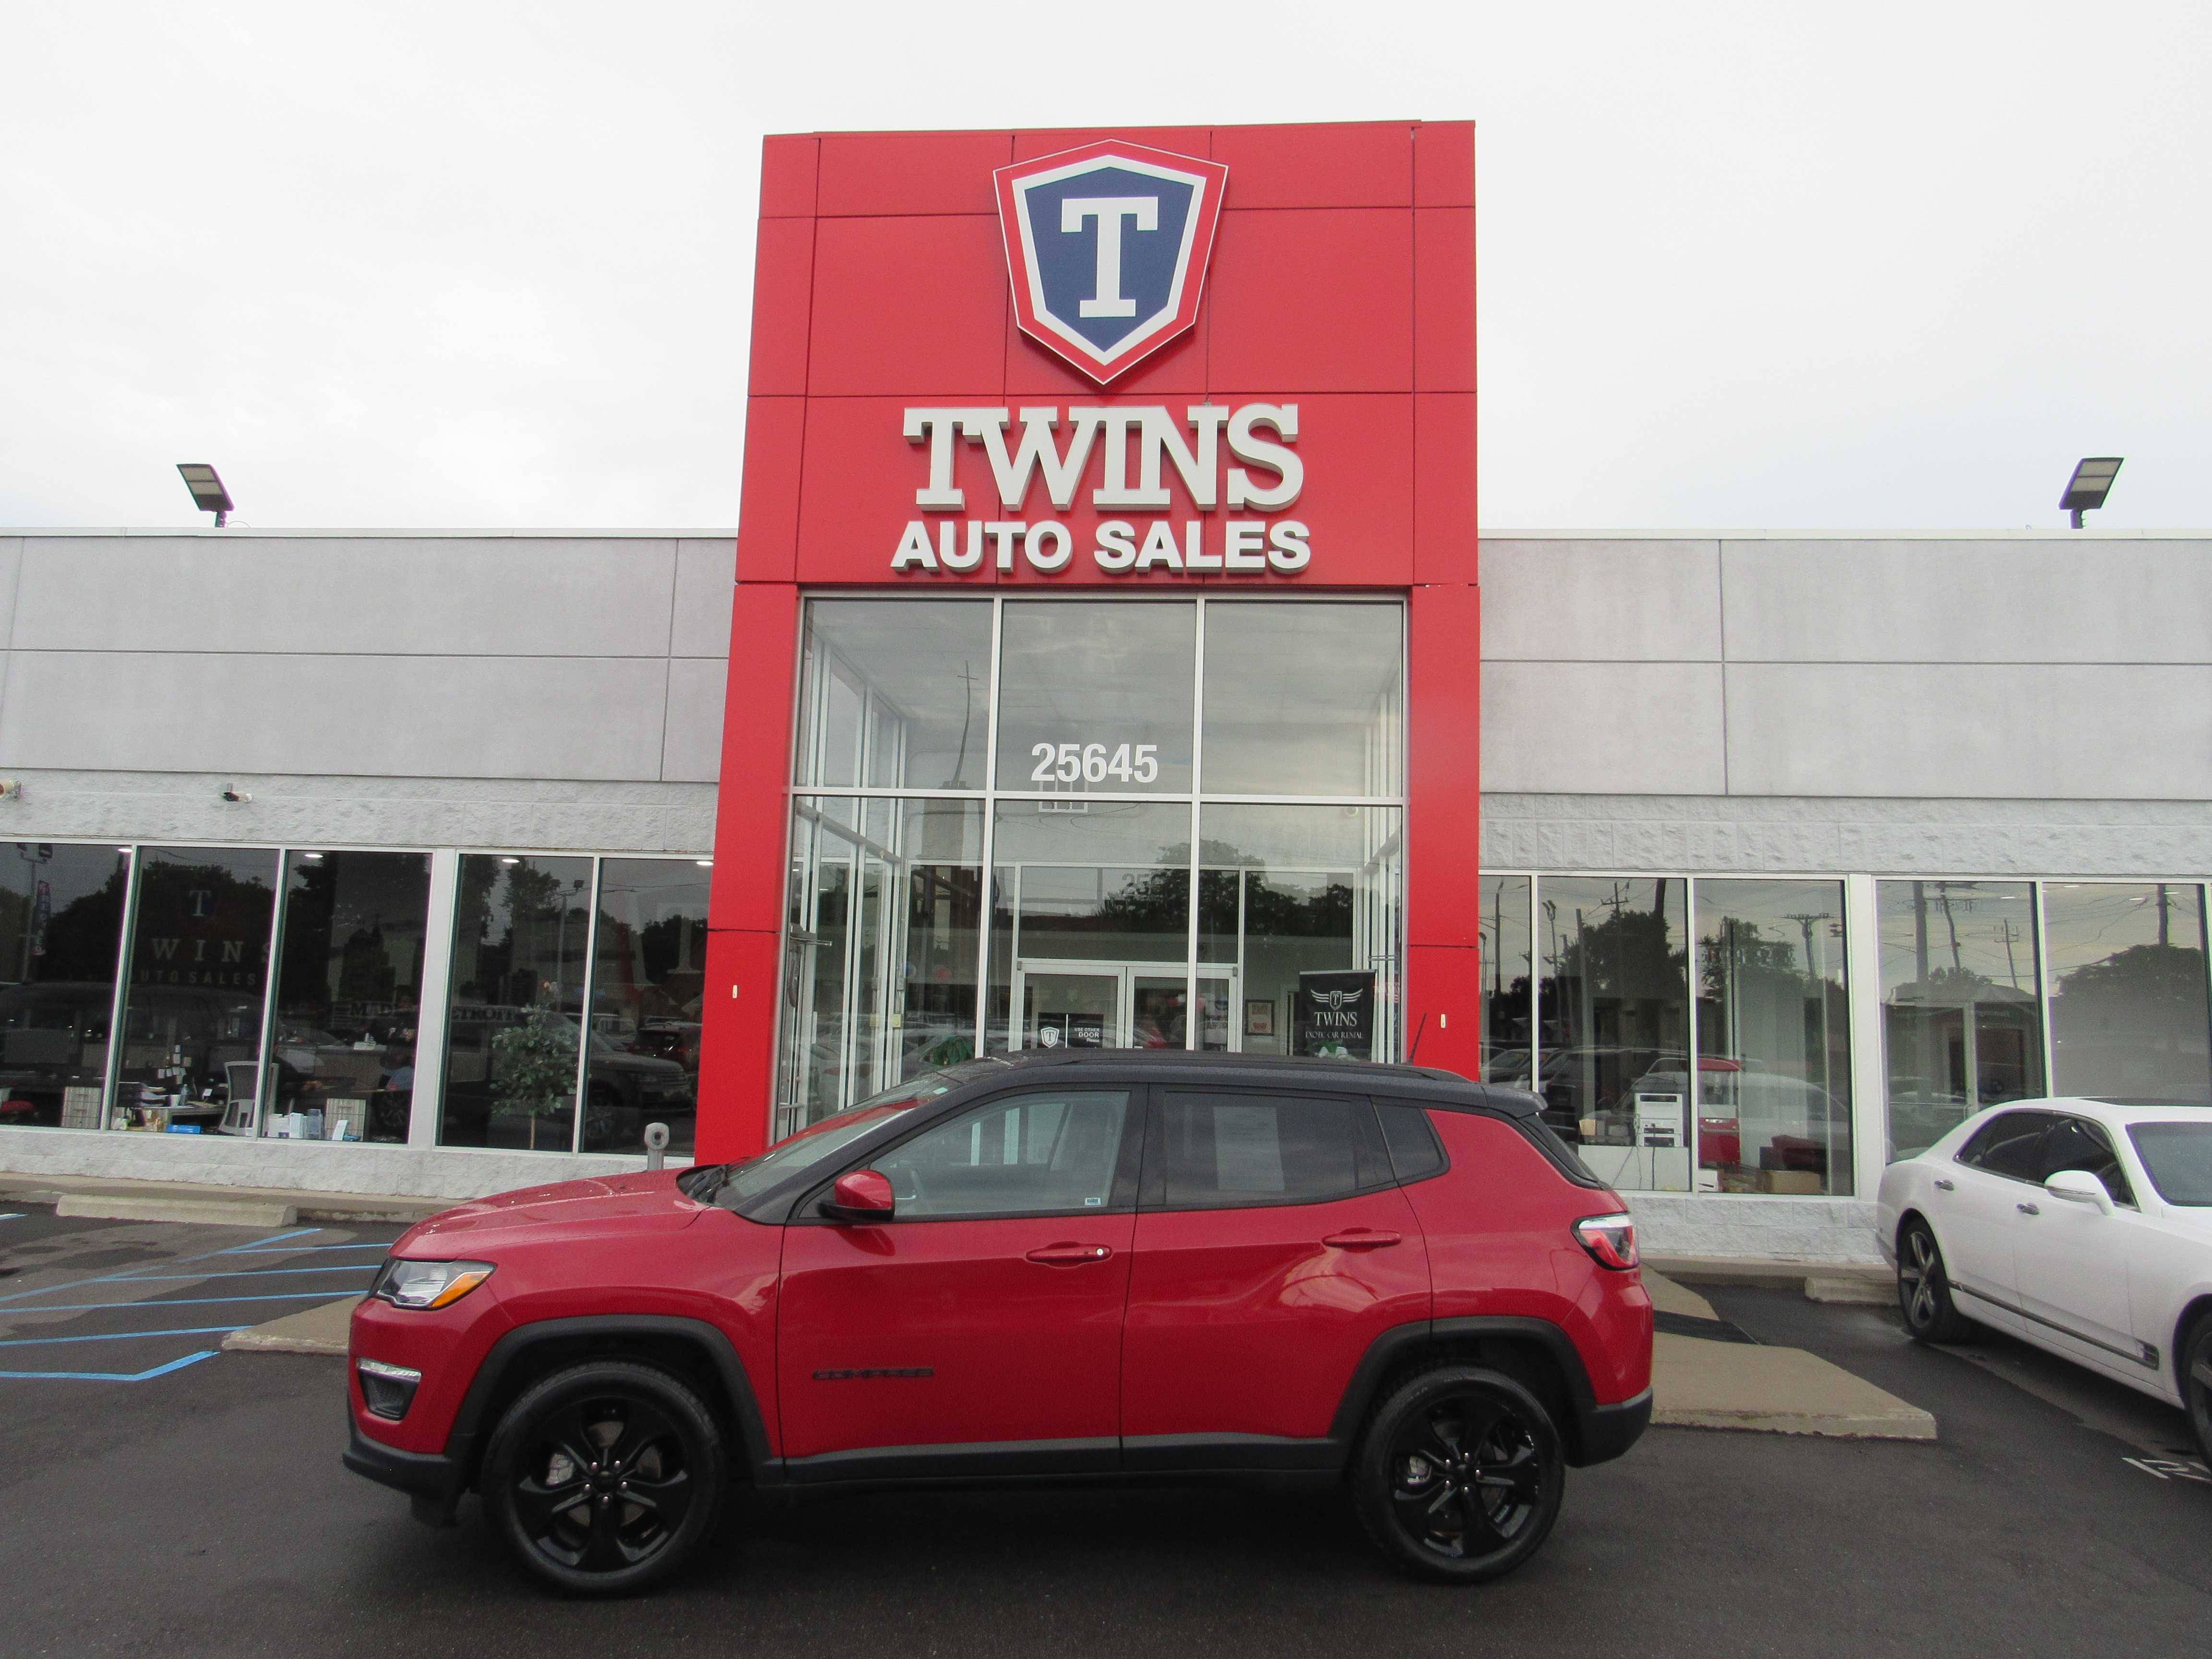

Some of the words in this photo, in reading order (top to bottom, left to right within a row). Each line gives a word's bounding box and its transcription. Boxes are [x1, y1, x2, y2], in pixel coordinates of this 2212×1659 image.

[1061, 196, 1158, 318] T
[903, 404, 1304, 512] TWINS
[890, 520, 1073, 573] AUTO
[1094, 520, 1311, 574] SALES
[1031, 743, 1158, 782] 25645
[191, 891, 211, 916] T
[140, 969, 177, 983] UTO
[188, 971, 256, 985] SALES
[1332, 994, 1339, 1005] T
[1314, 1012, 1357, 1026] TWINS
